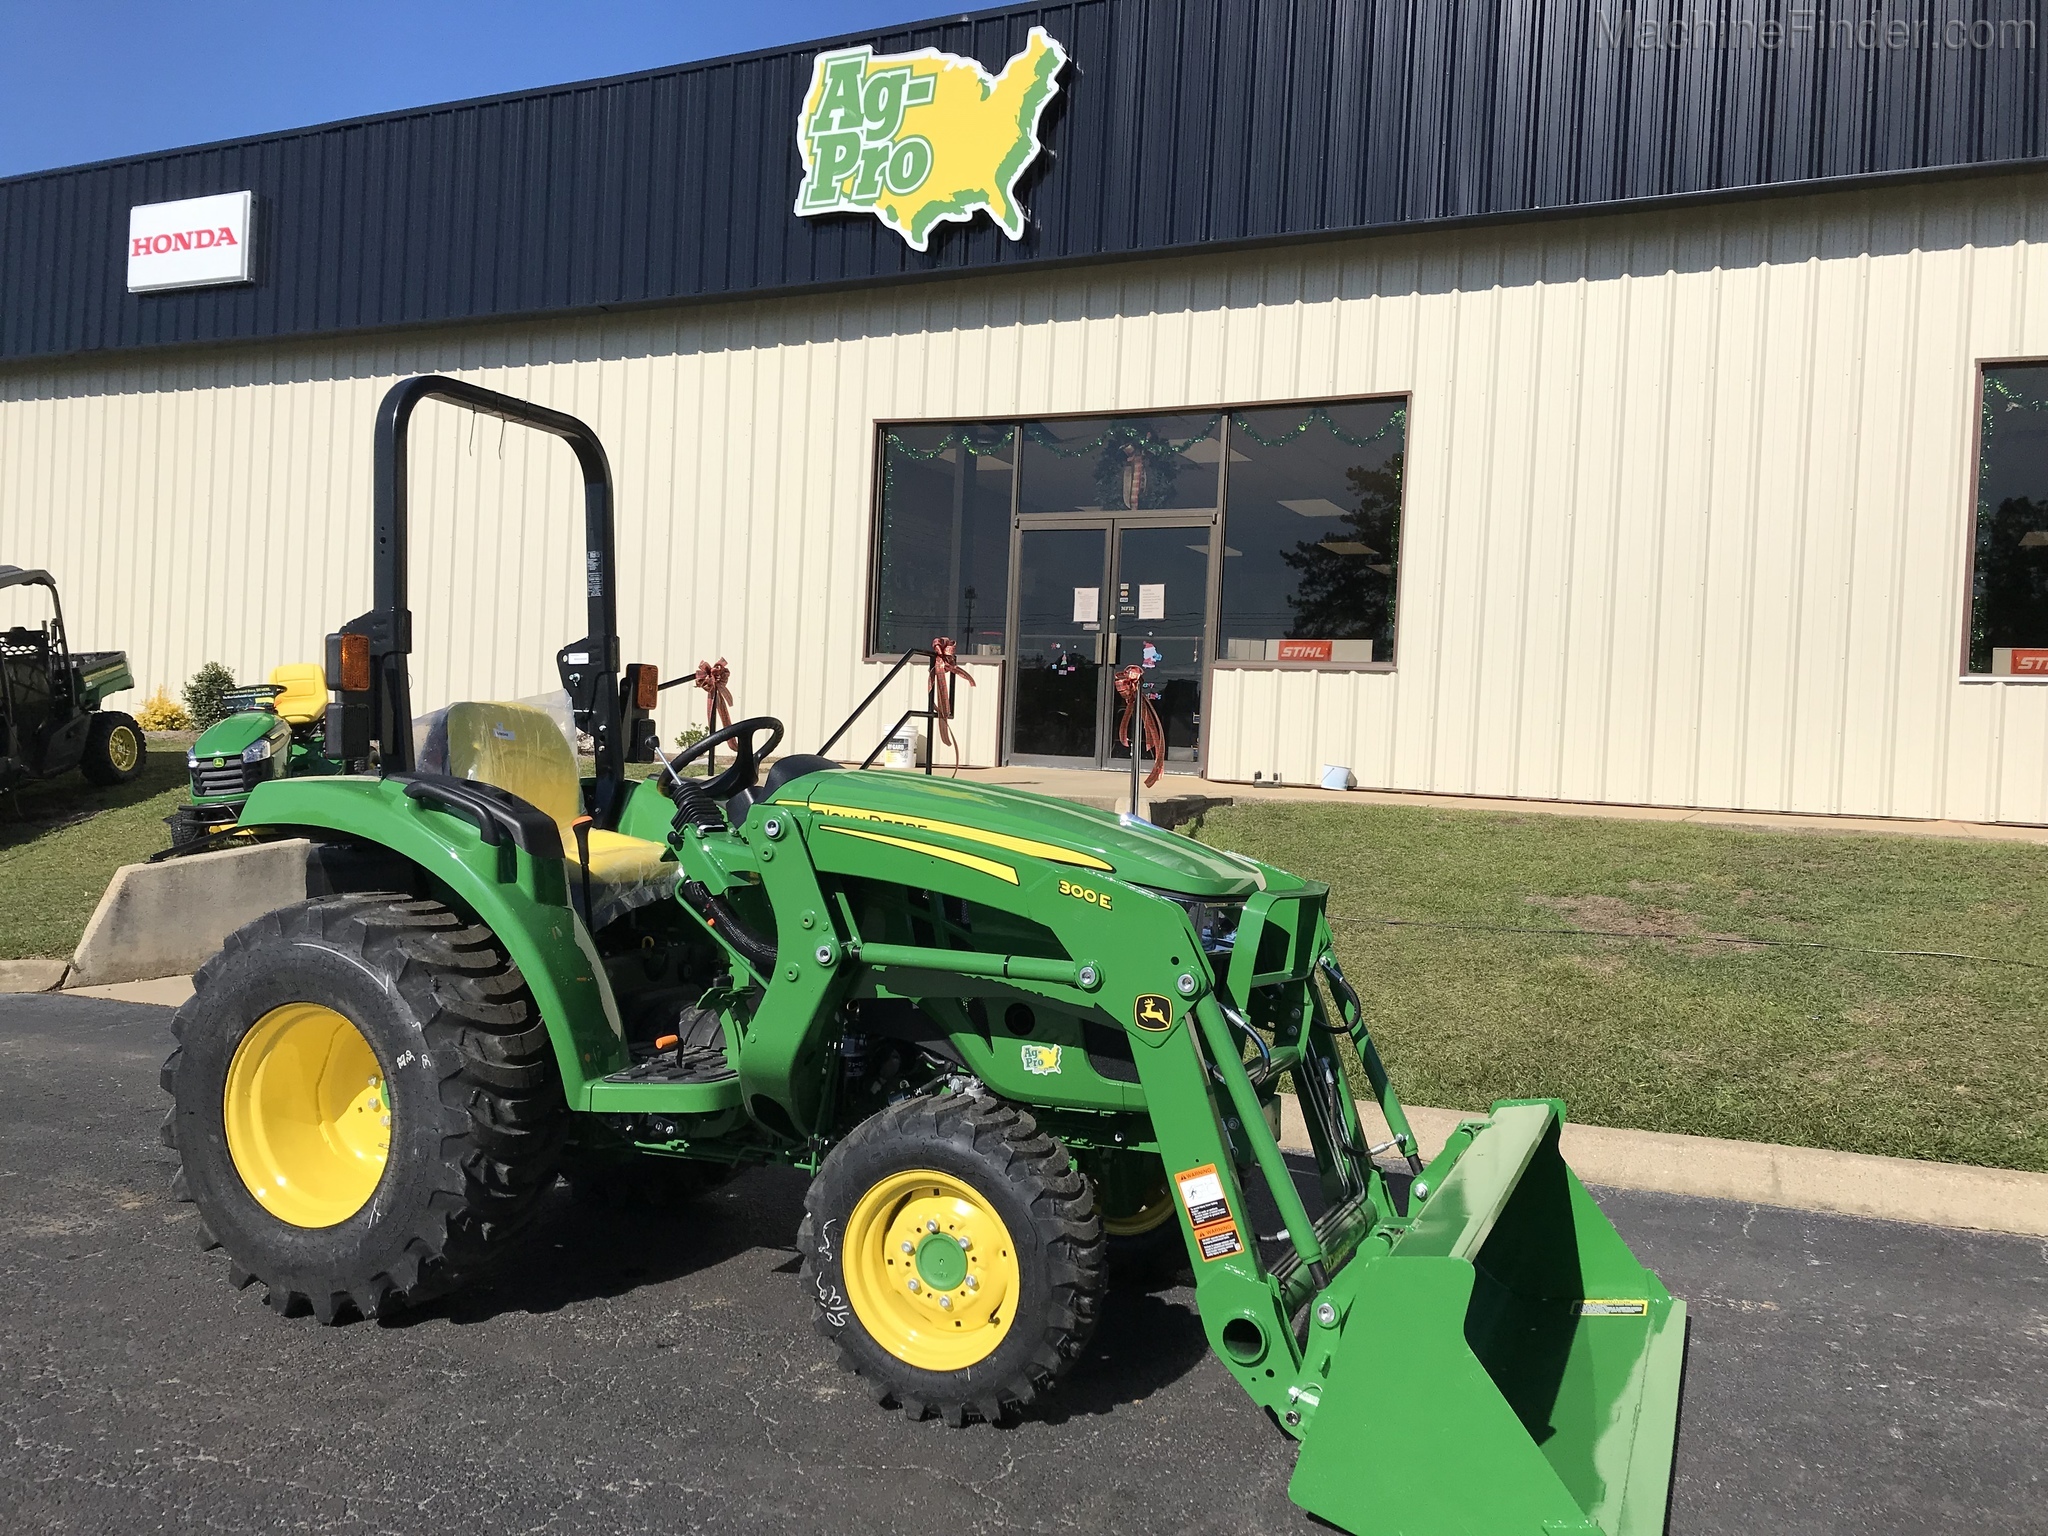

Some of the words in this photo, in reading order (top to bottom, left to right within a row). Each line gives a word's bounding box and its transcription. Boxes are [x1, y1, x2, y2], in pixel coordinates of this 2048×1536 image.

[807, 54, 936, 142] Ag-
[805, 129, 933, 207] Pro
[131, 226, 238, 257] HONDA
[1281, 646, 1325, 658] STIHL
[1026, 1058, 1044, 1068] Pro
